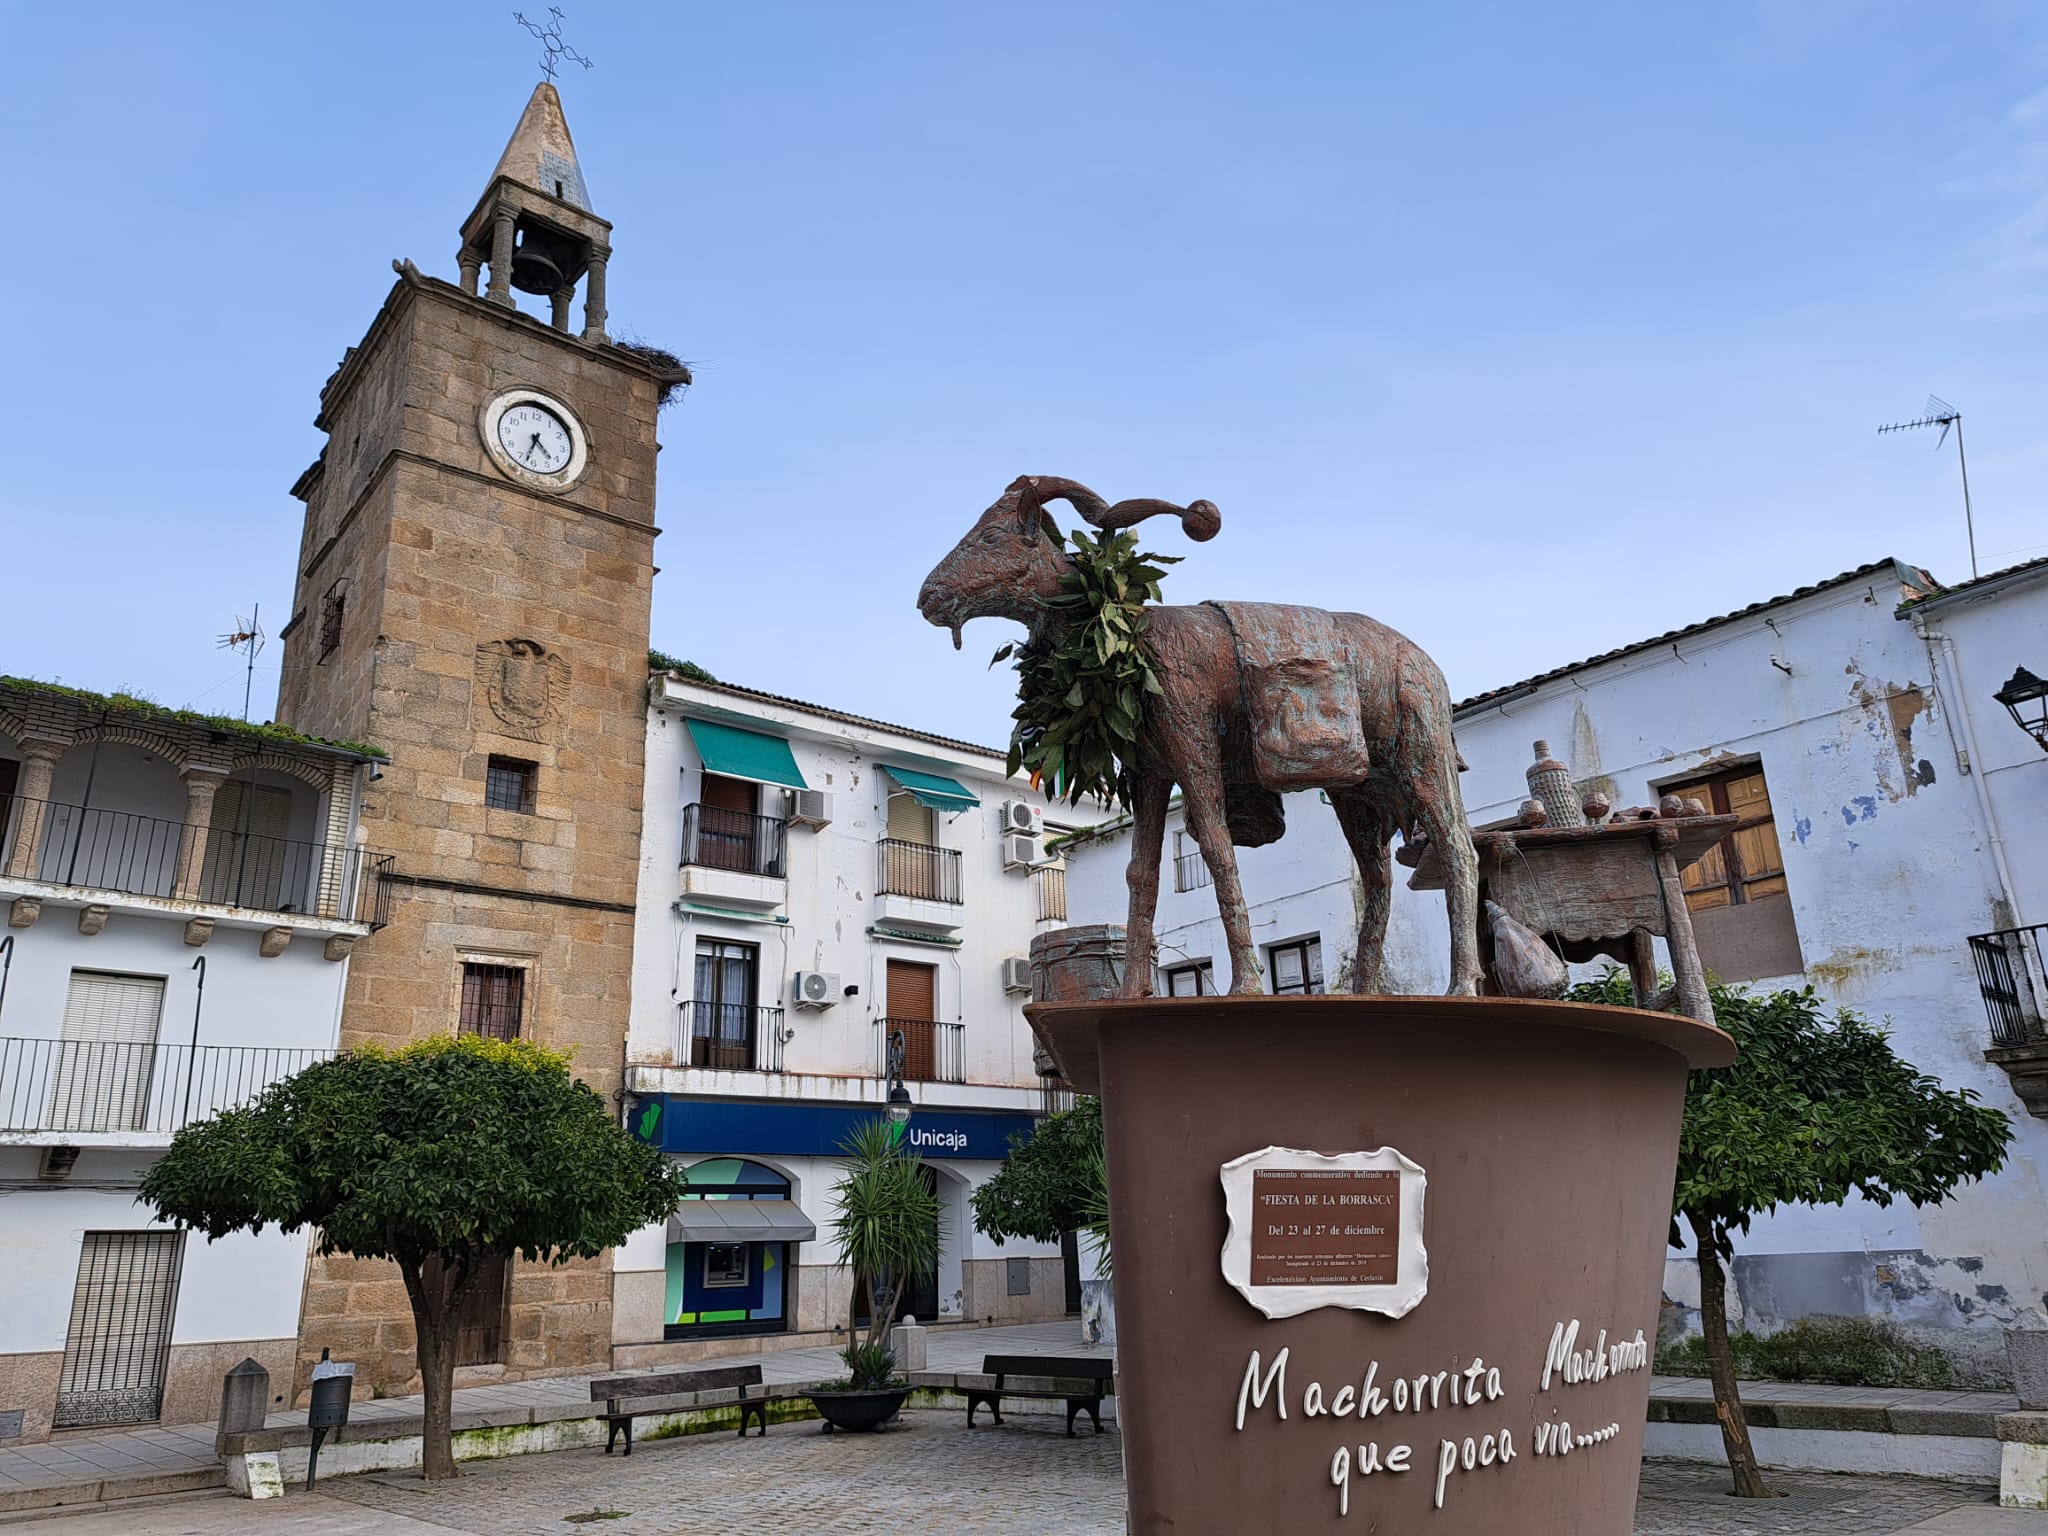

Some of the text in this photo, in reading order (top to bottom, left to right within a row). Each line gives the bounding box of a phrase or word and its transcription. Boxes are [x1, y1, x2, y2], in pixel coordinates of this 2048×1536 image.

[520, 412, 527, 421] 11
[532, 412, 542, 422] 12
[510, 417, 520, 426] 10
[548, 420, 552, 428] 1
[556, 432, 562, 440] 2
[560, 445, 565, 453] 3
[518, 451, 524, 459] 7
[554, 455, 560, 463] 4
[530, 459, 537, 467] 6
[910, 1128, 967, 1151] Unicaja
[1256, 1170, 1297, 1178] Monumento
[1354, 1170, 1382, 1178] dedicado
[1304, 1194, 1318, 1205] DE
[1323, 1195, 1335, 1205] LA
[1268, 1225, 1384, 1235] Del 23 al 27 de diciembre
[1236, 1347, 1504, 1430] Machorrita
[1331, 1442, 1412, 1516] que
[1434, 1428, 1517, 1509] poca
